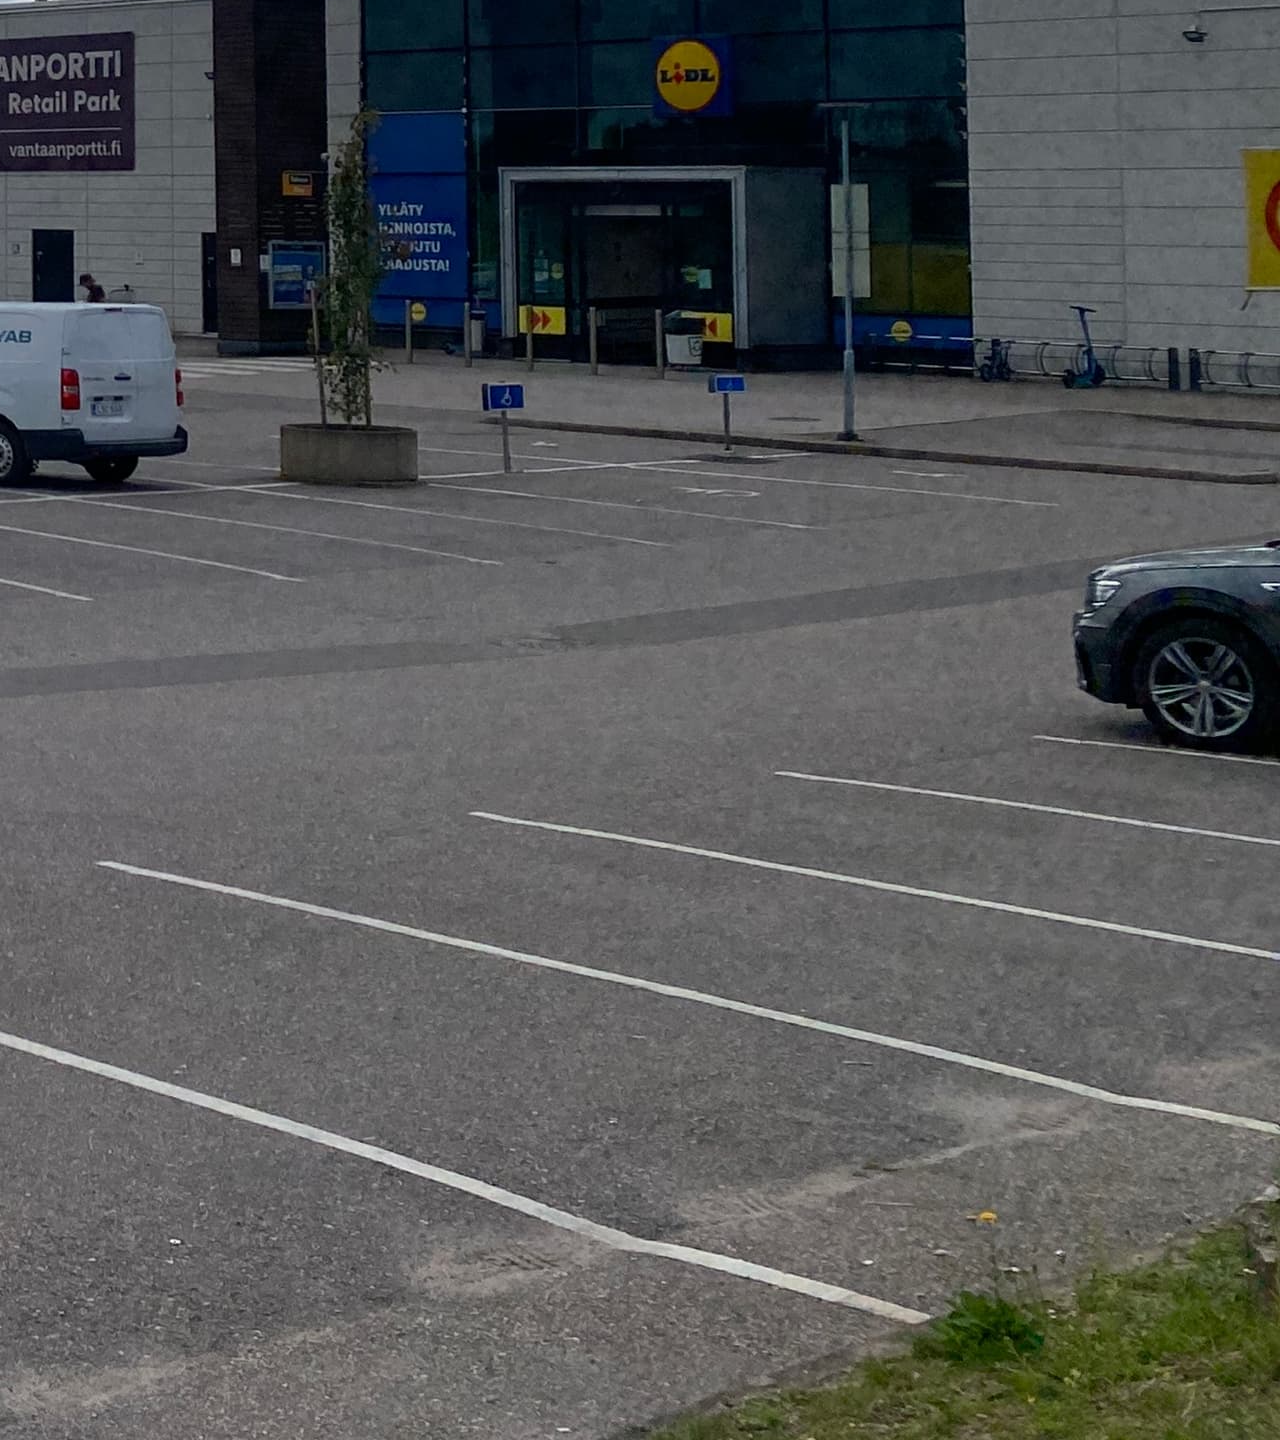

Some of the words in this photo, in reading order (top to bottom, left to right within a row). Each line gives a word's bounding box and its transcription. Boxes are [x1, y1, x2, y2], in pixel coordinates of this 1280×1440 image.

[9, 90, 67, 115] Retail
[74, 89, 121, 112] Park
[9, 140, 121, 160] vantaanportti.fi
